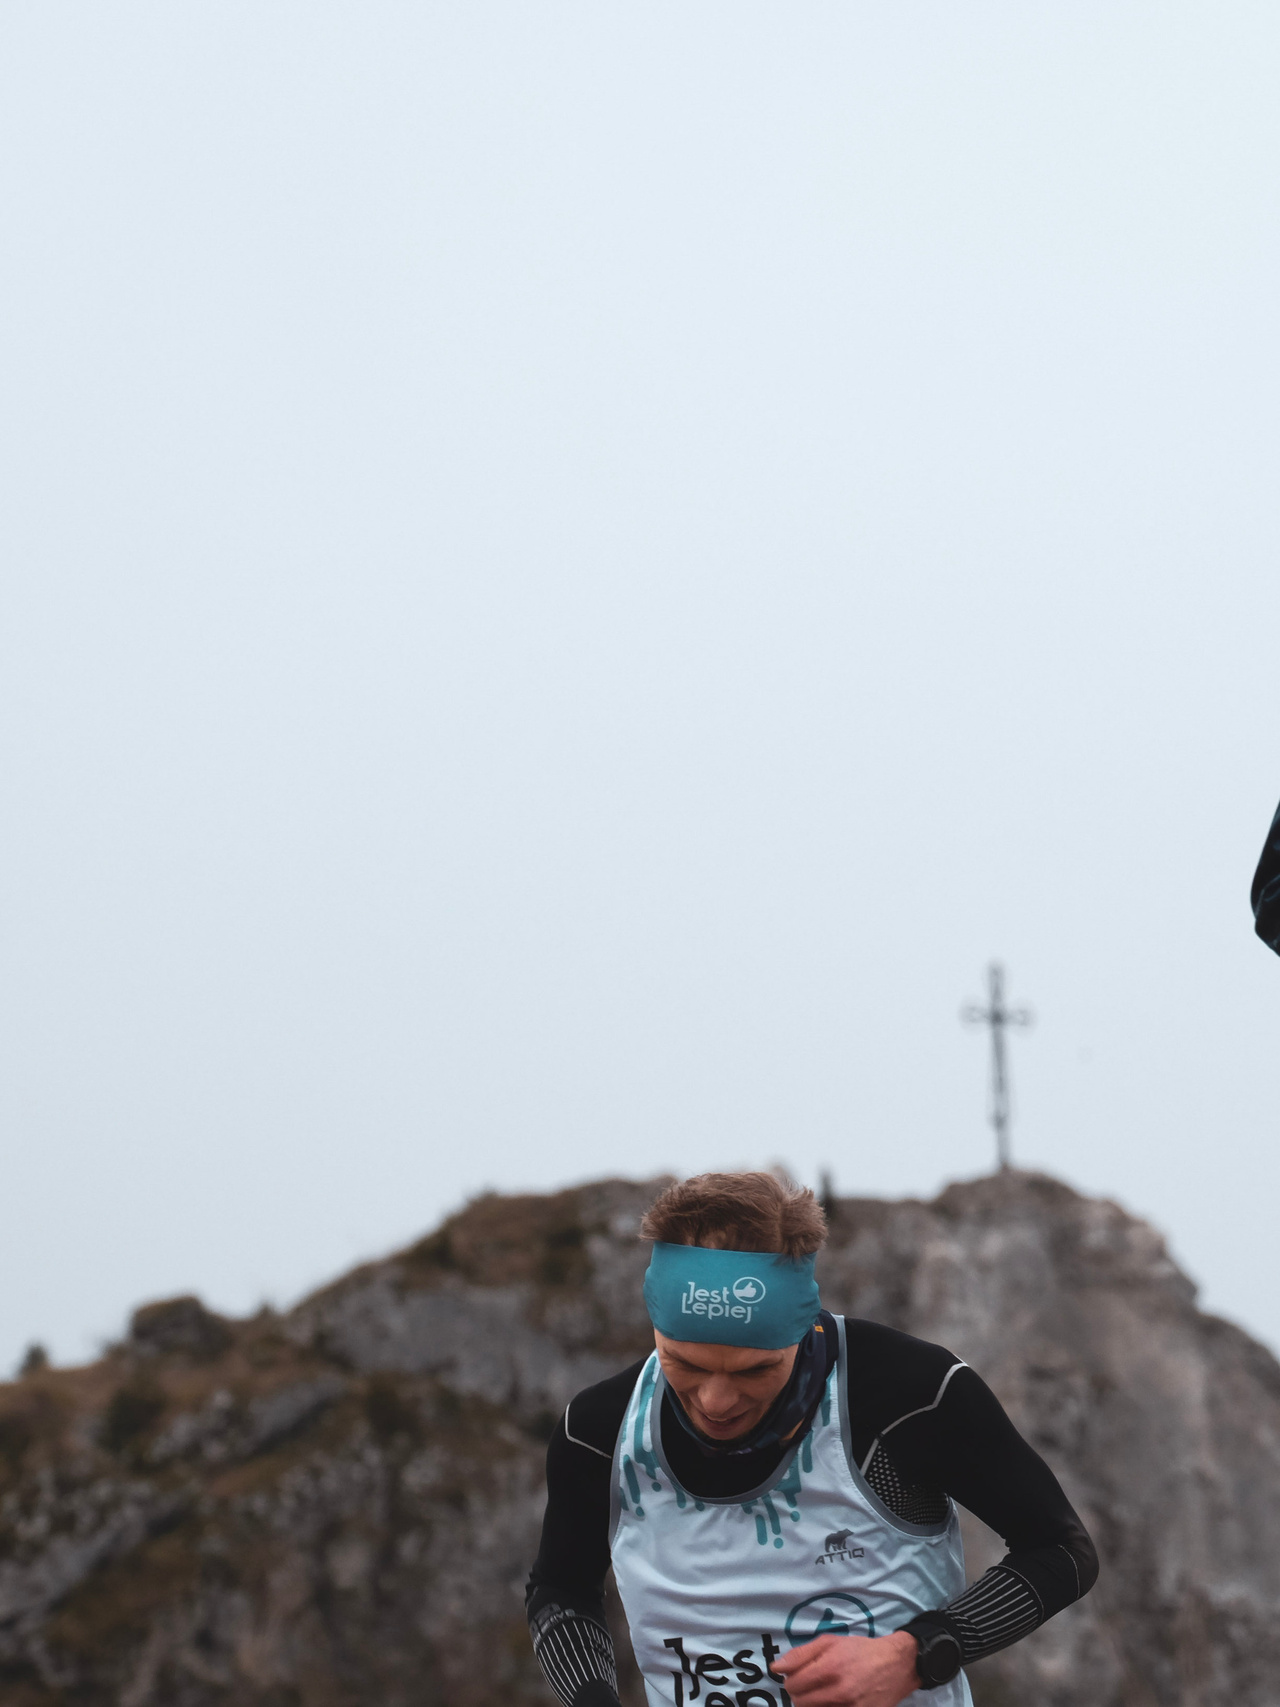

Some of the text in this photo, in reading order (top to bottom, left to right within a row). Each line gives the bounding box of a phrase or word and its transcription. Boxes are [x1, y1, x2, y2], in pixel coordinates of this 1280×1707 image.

[687, 1281, 730, 1305] Jest
[681, 1292, 752, 1325] Lepiej
[815, 1547, 866, 1566] ATTIQ
[663, 1633, 785, 1701] Jest
